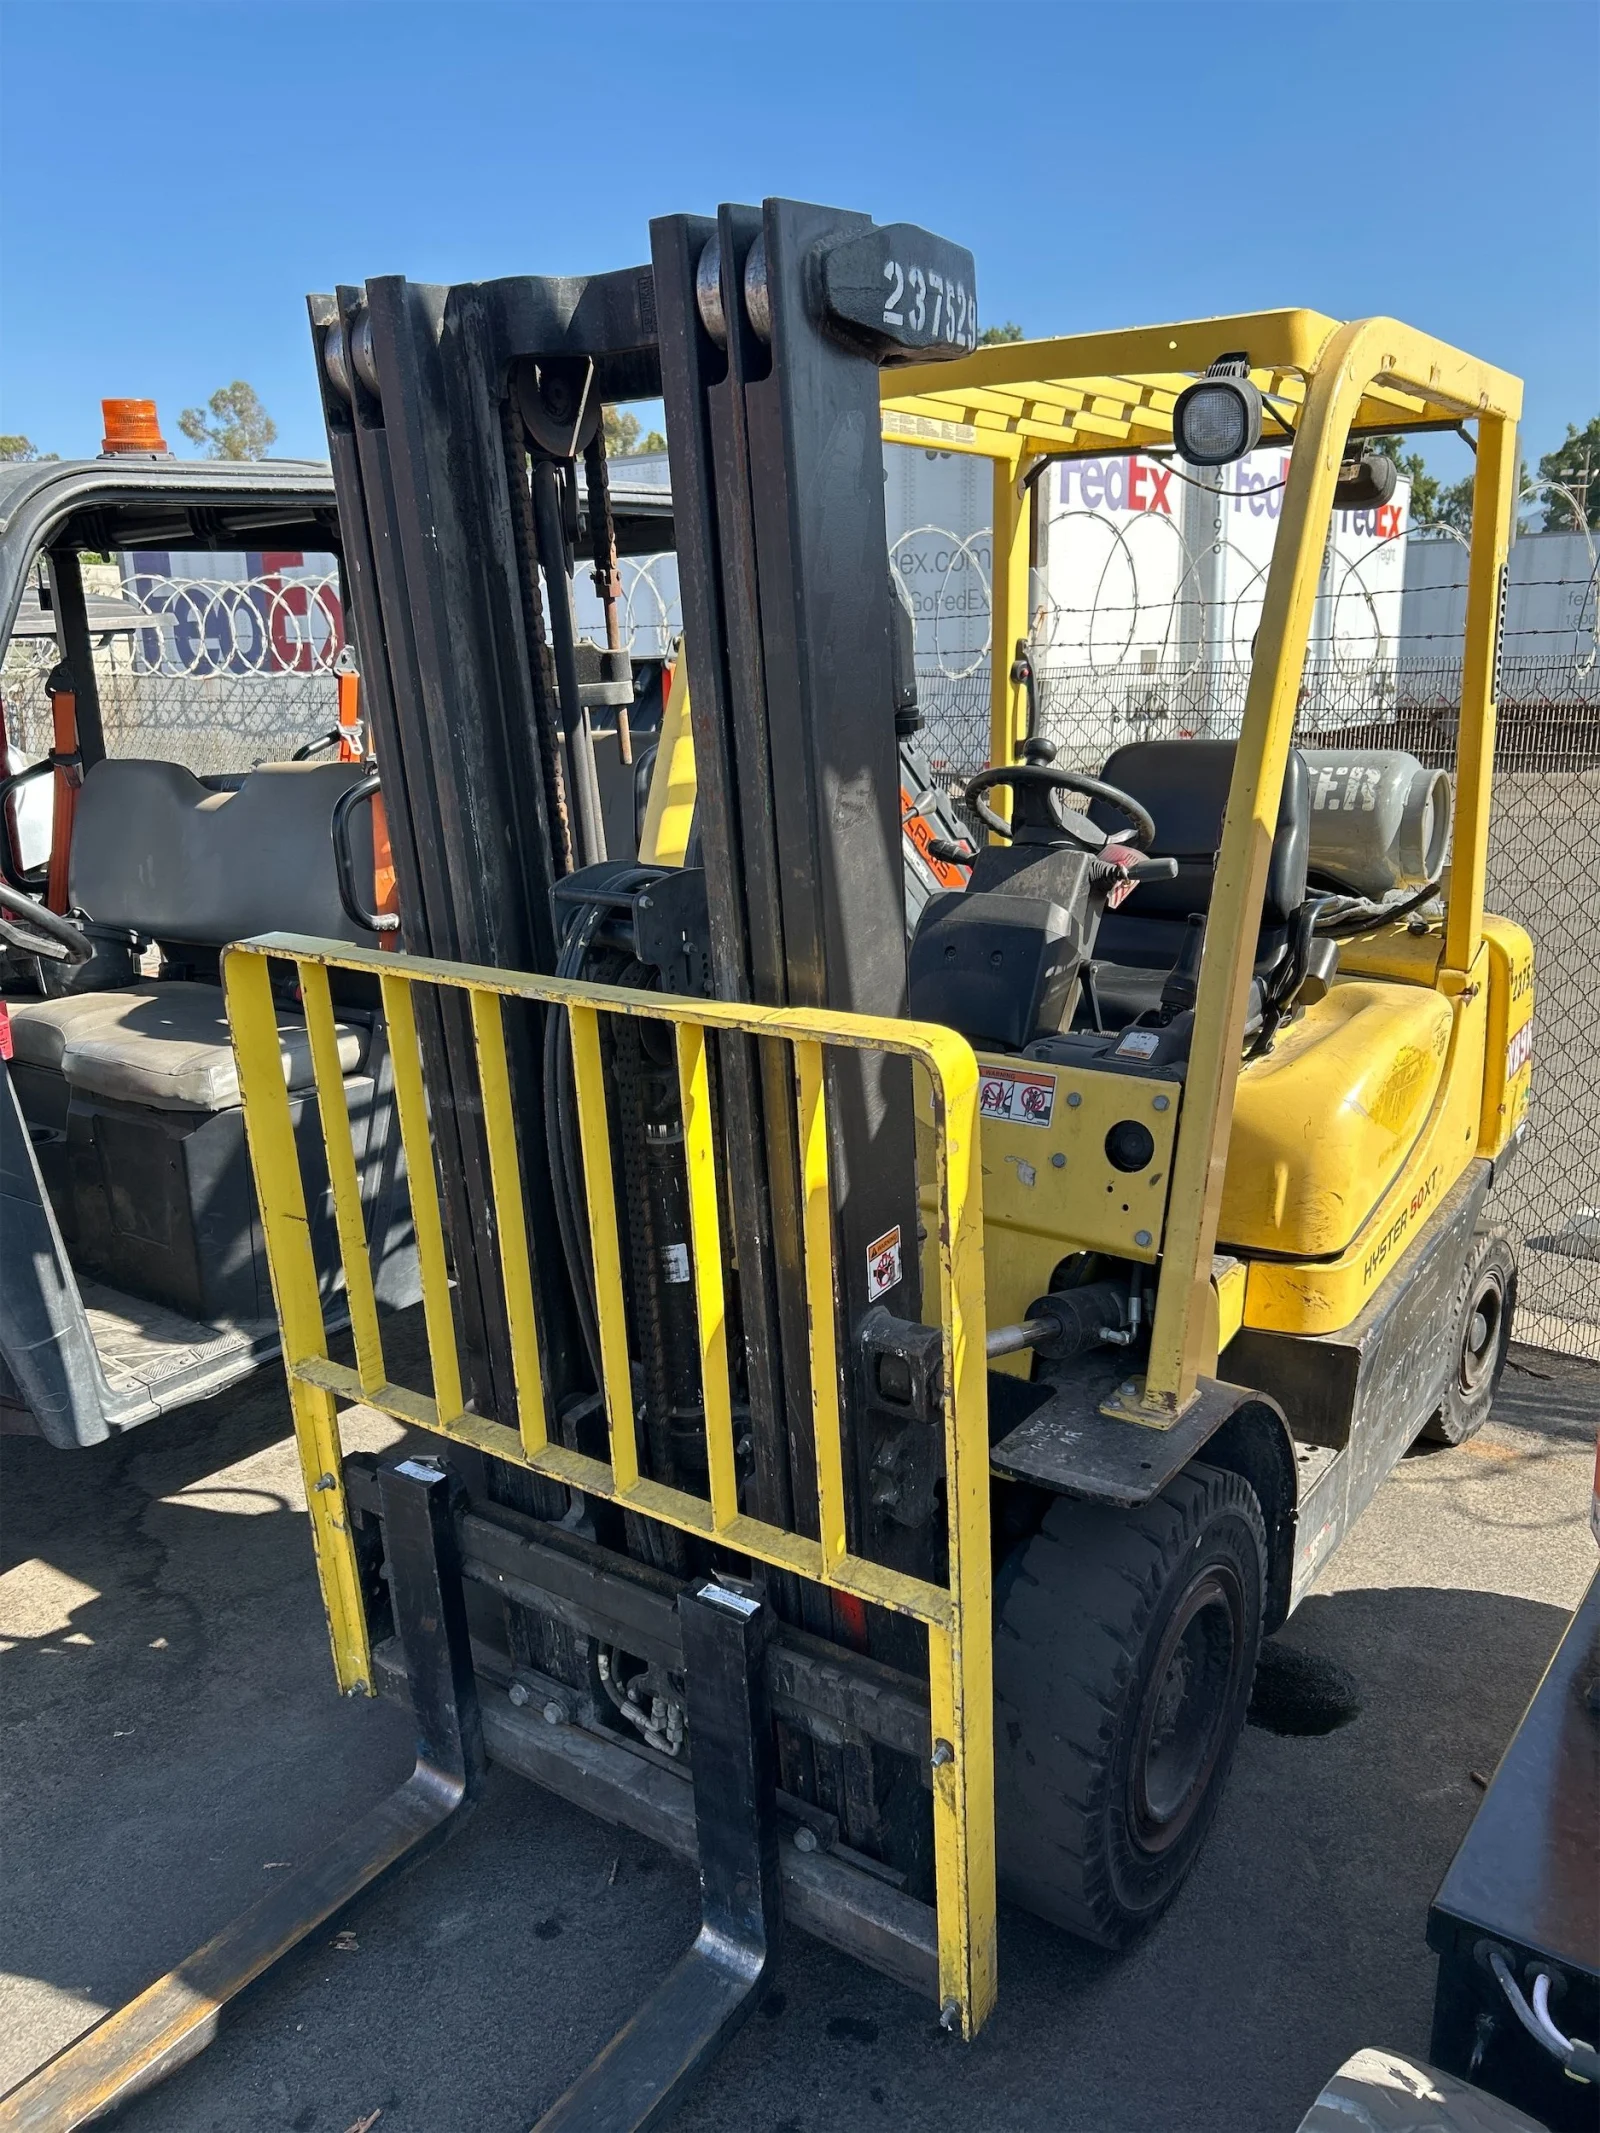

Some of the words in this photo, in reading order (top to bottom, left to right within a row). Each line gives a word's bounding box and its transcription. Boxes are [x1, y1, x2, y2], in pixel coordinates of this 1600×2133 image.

[883, 261, 976, 350] 237529
[1363, 1208, 1408, 1286] HYSTER
[1410, 1166, 1438, 1219] 50XT
